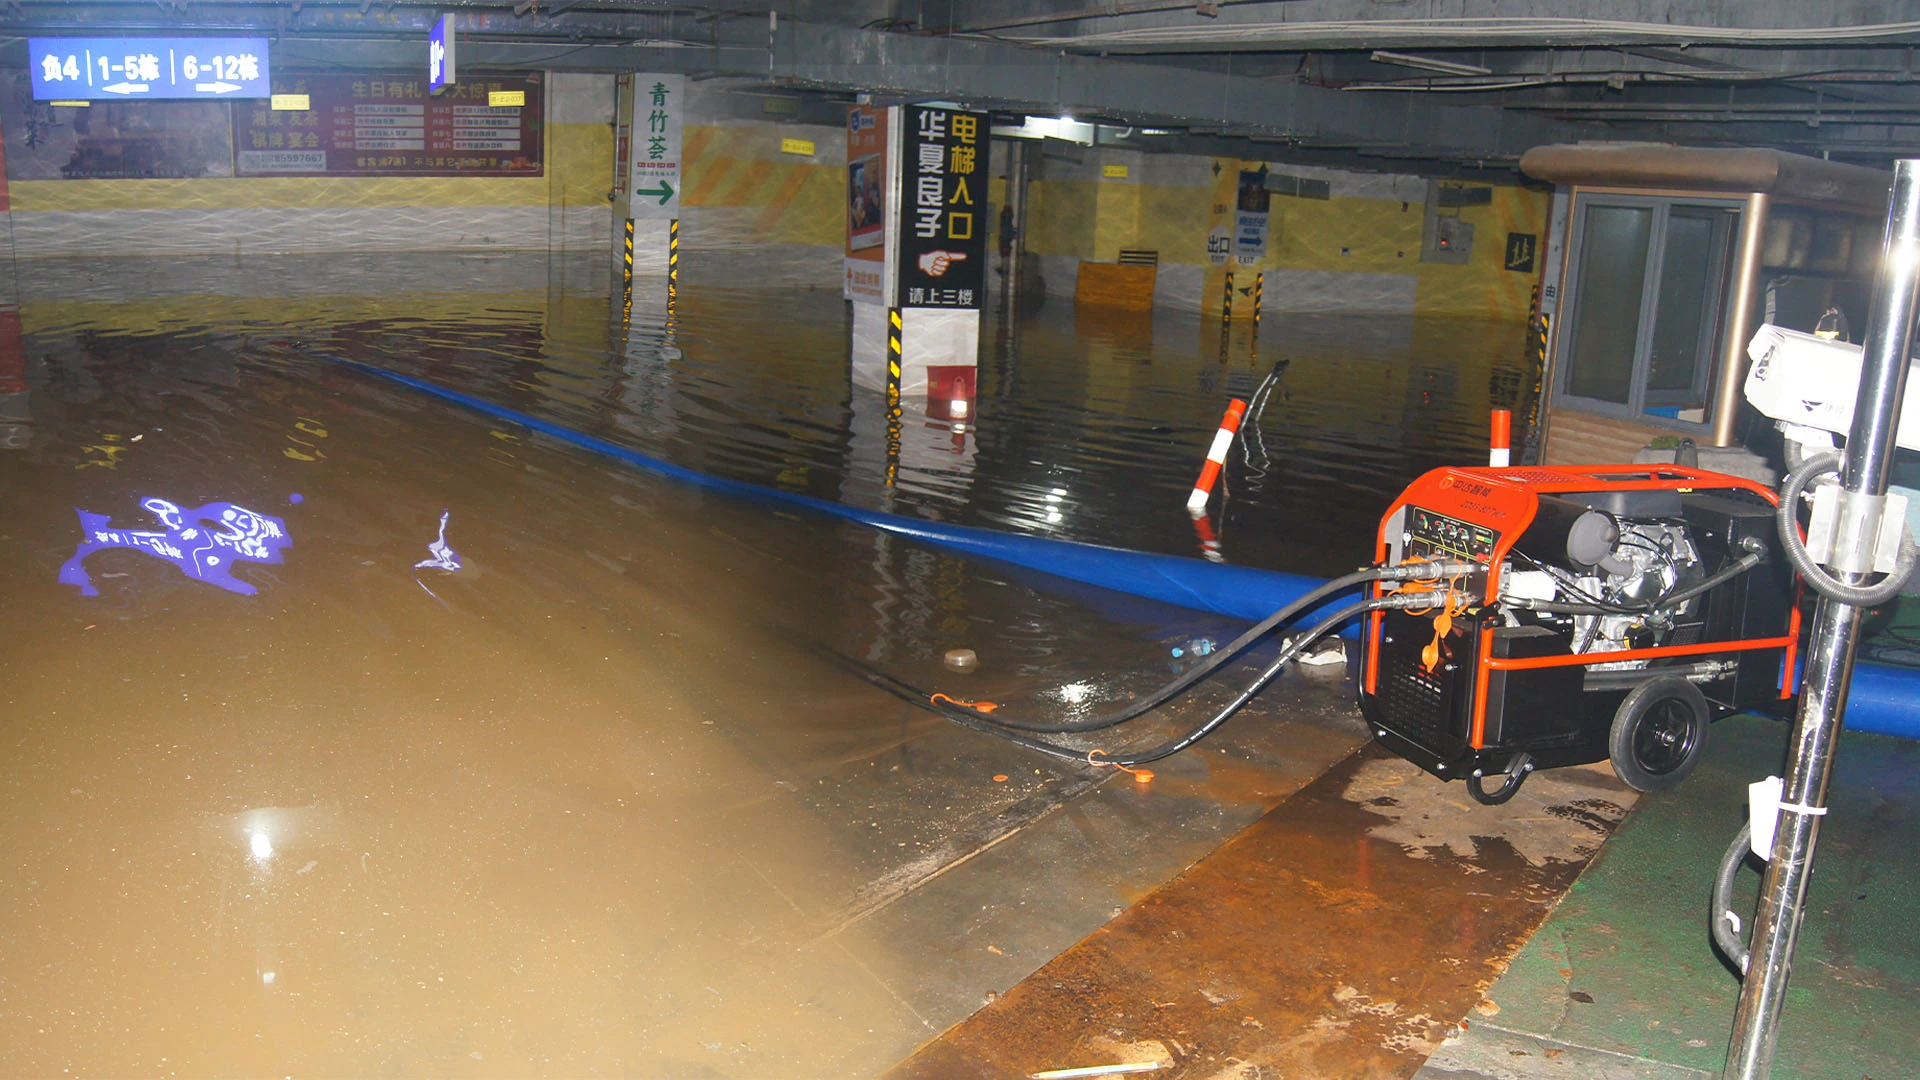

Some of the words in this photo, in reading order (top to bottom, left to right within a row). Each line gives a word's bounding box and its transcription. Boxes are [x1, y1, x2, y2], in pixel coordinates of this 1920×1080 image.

[41, 54, 80, 82] 负4
[98, 54, 160, 81] 1-5栋
[183, 54, 259, 81] 6-12栋
[351, 81, 422, 99] 生日有礼
[446, 82, 504, 99] 大惊喜
[648, 82, 671, 160] 青竹荟
[914, 110, 946, 238] 华夏良子
[947, 114, 977, 240] 电梯入口
[1208, 234, 1231, 253] 出口
[909, 287, 973, 306] 请上三楼
